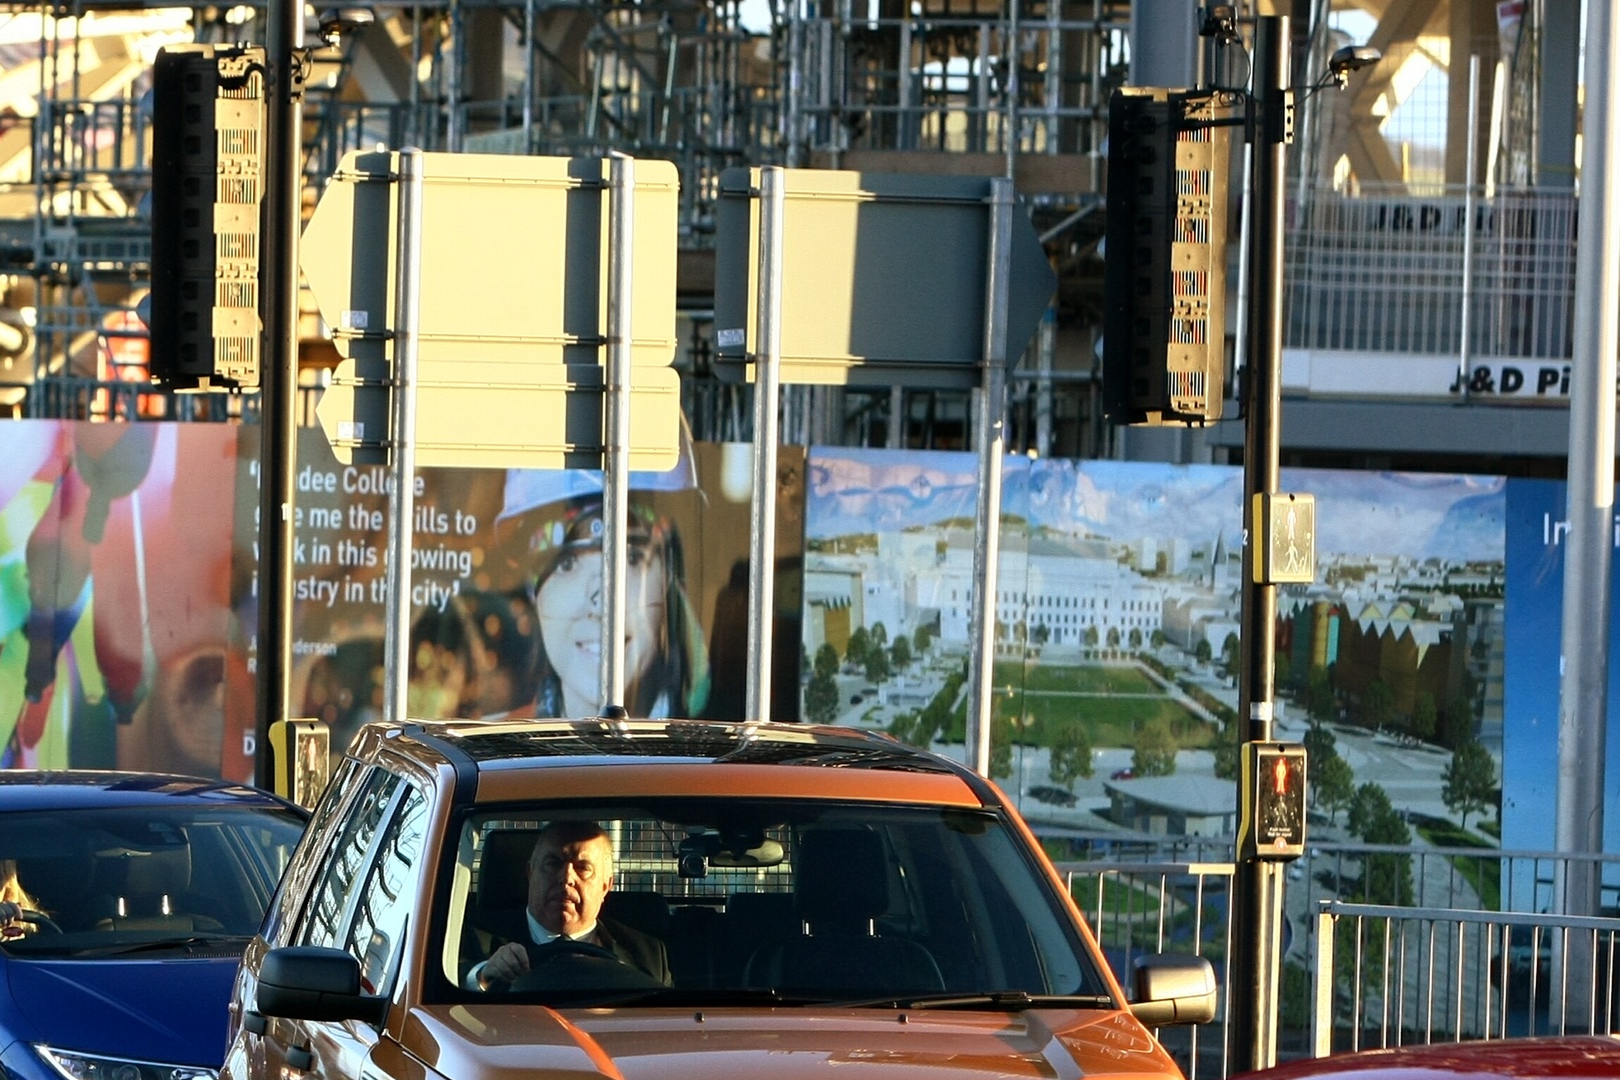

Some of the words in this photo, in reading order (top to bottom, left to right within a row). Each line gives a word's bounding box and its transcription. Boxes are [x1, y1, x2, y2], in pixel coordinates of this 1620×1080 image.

[342, 465, 425, 496] Collee
[309, 507, 343, 530] me
[348, 502, 383, 531] the
[455, 508, 477, 535] to
[312, 536, 331, 565] in
[337, 538, 378, 568] this
[344, 575, 364, 603] in
